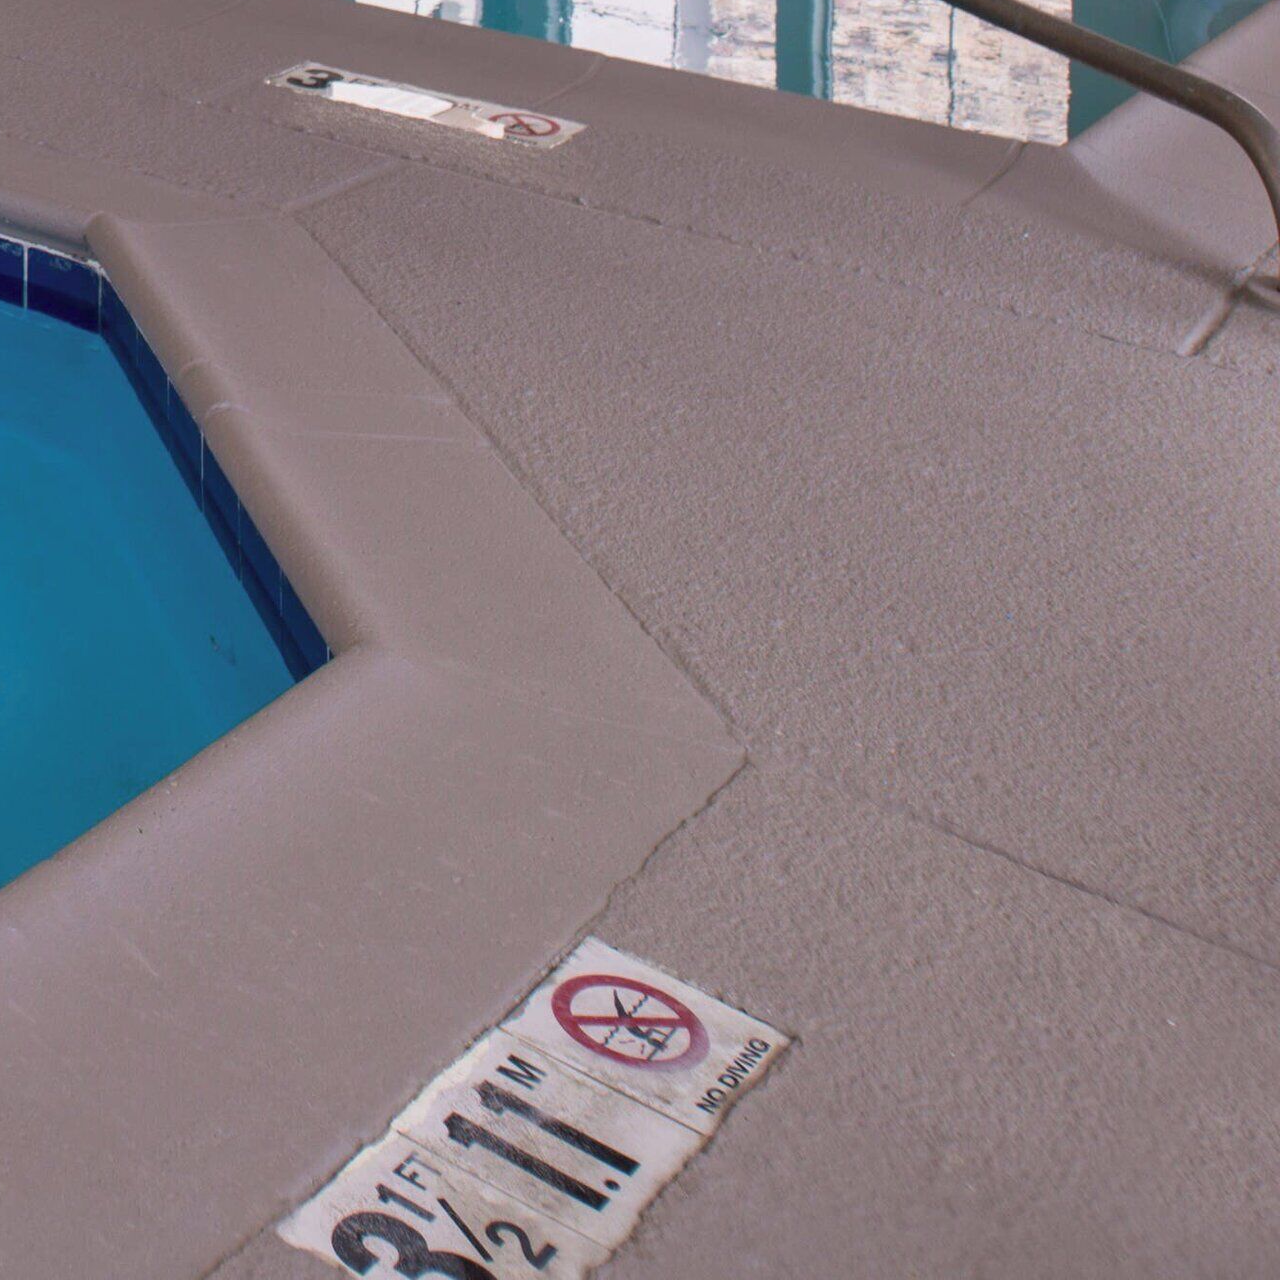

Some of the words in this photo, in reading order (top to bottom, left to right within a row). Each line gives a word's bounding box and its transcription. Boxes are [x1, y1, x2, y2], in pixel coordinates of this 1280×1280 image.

[392, 1149, 443, 1191] FT
[497, 1053, 547, 1090] M
[695, 1088, 727, 1116] NO
[716, 1038, 771, 1091] DIVING
